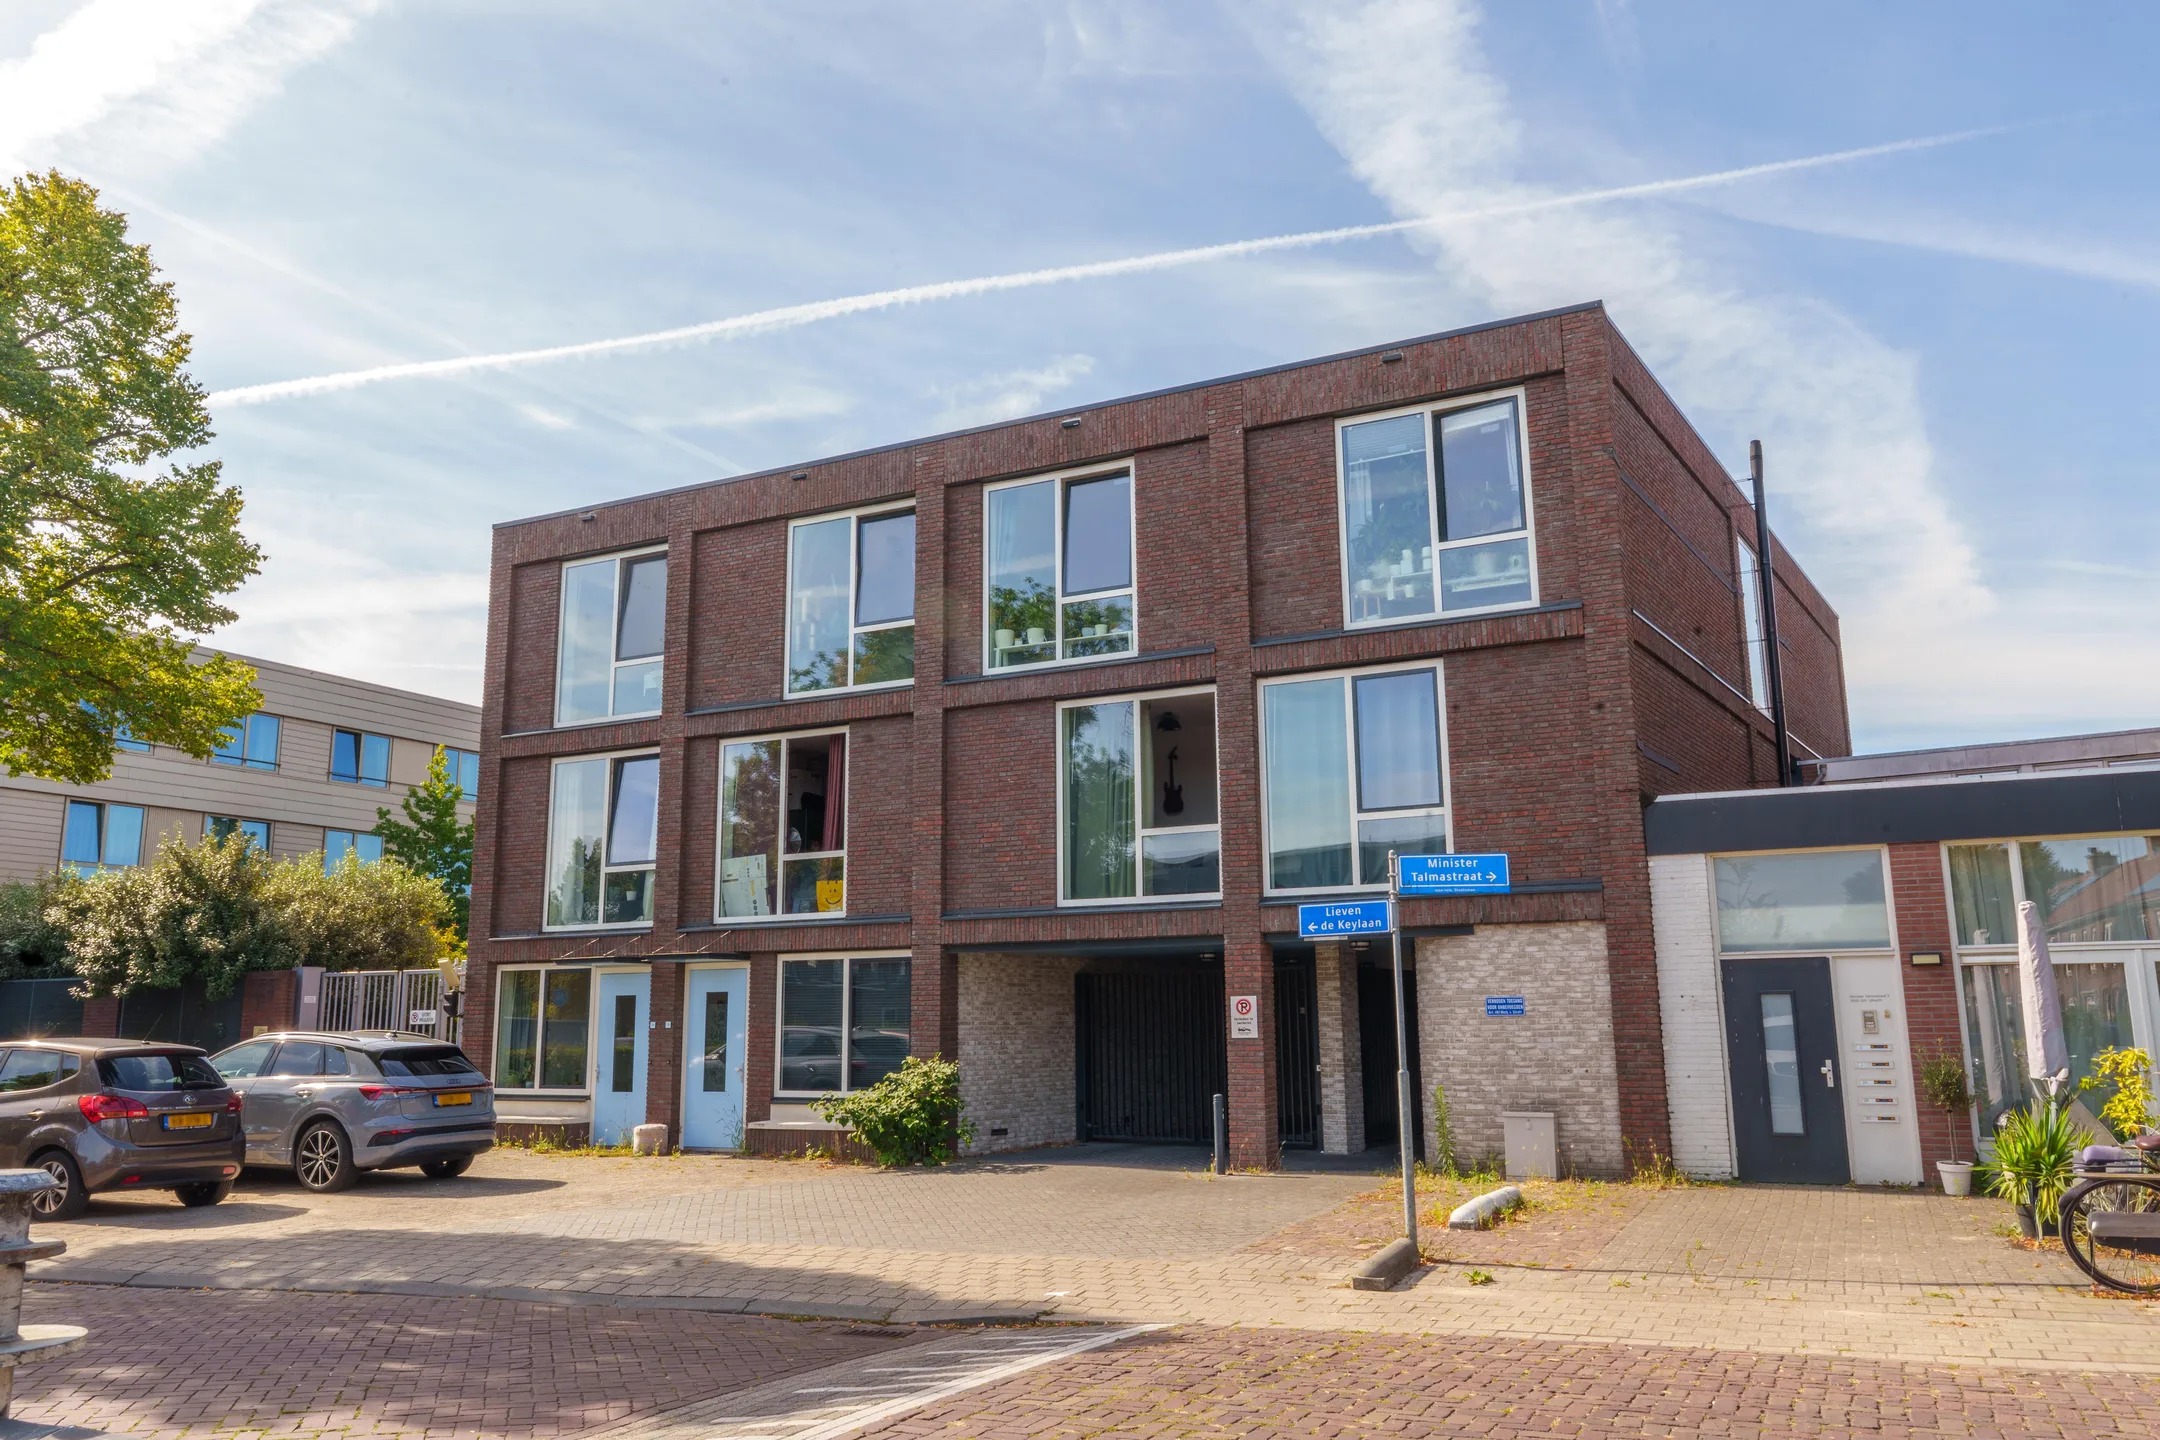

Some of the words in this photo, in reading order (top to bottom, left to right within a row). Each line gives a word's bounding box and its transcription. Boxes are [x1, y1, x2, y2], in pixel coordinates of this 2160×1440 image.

[1427, 858, 1478, 868] Minister
[1411, 872, 1482, 882] Talmastraat
[1325, 906, 1361, 917] Lieven
[1321, 921, 1334, 930] de
[1338, 919, 1382, 931] Keylaan
